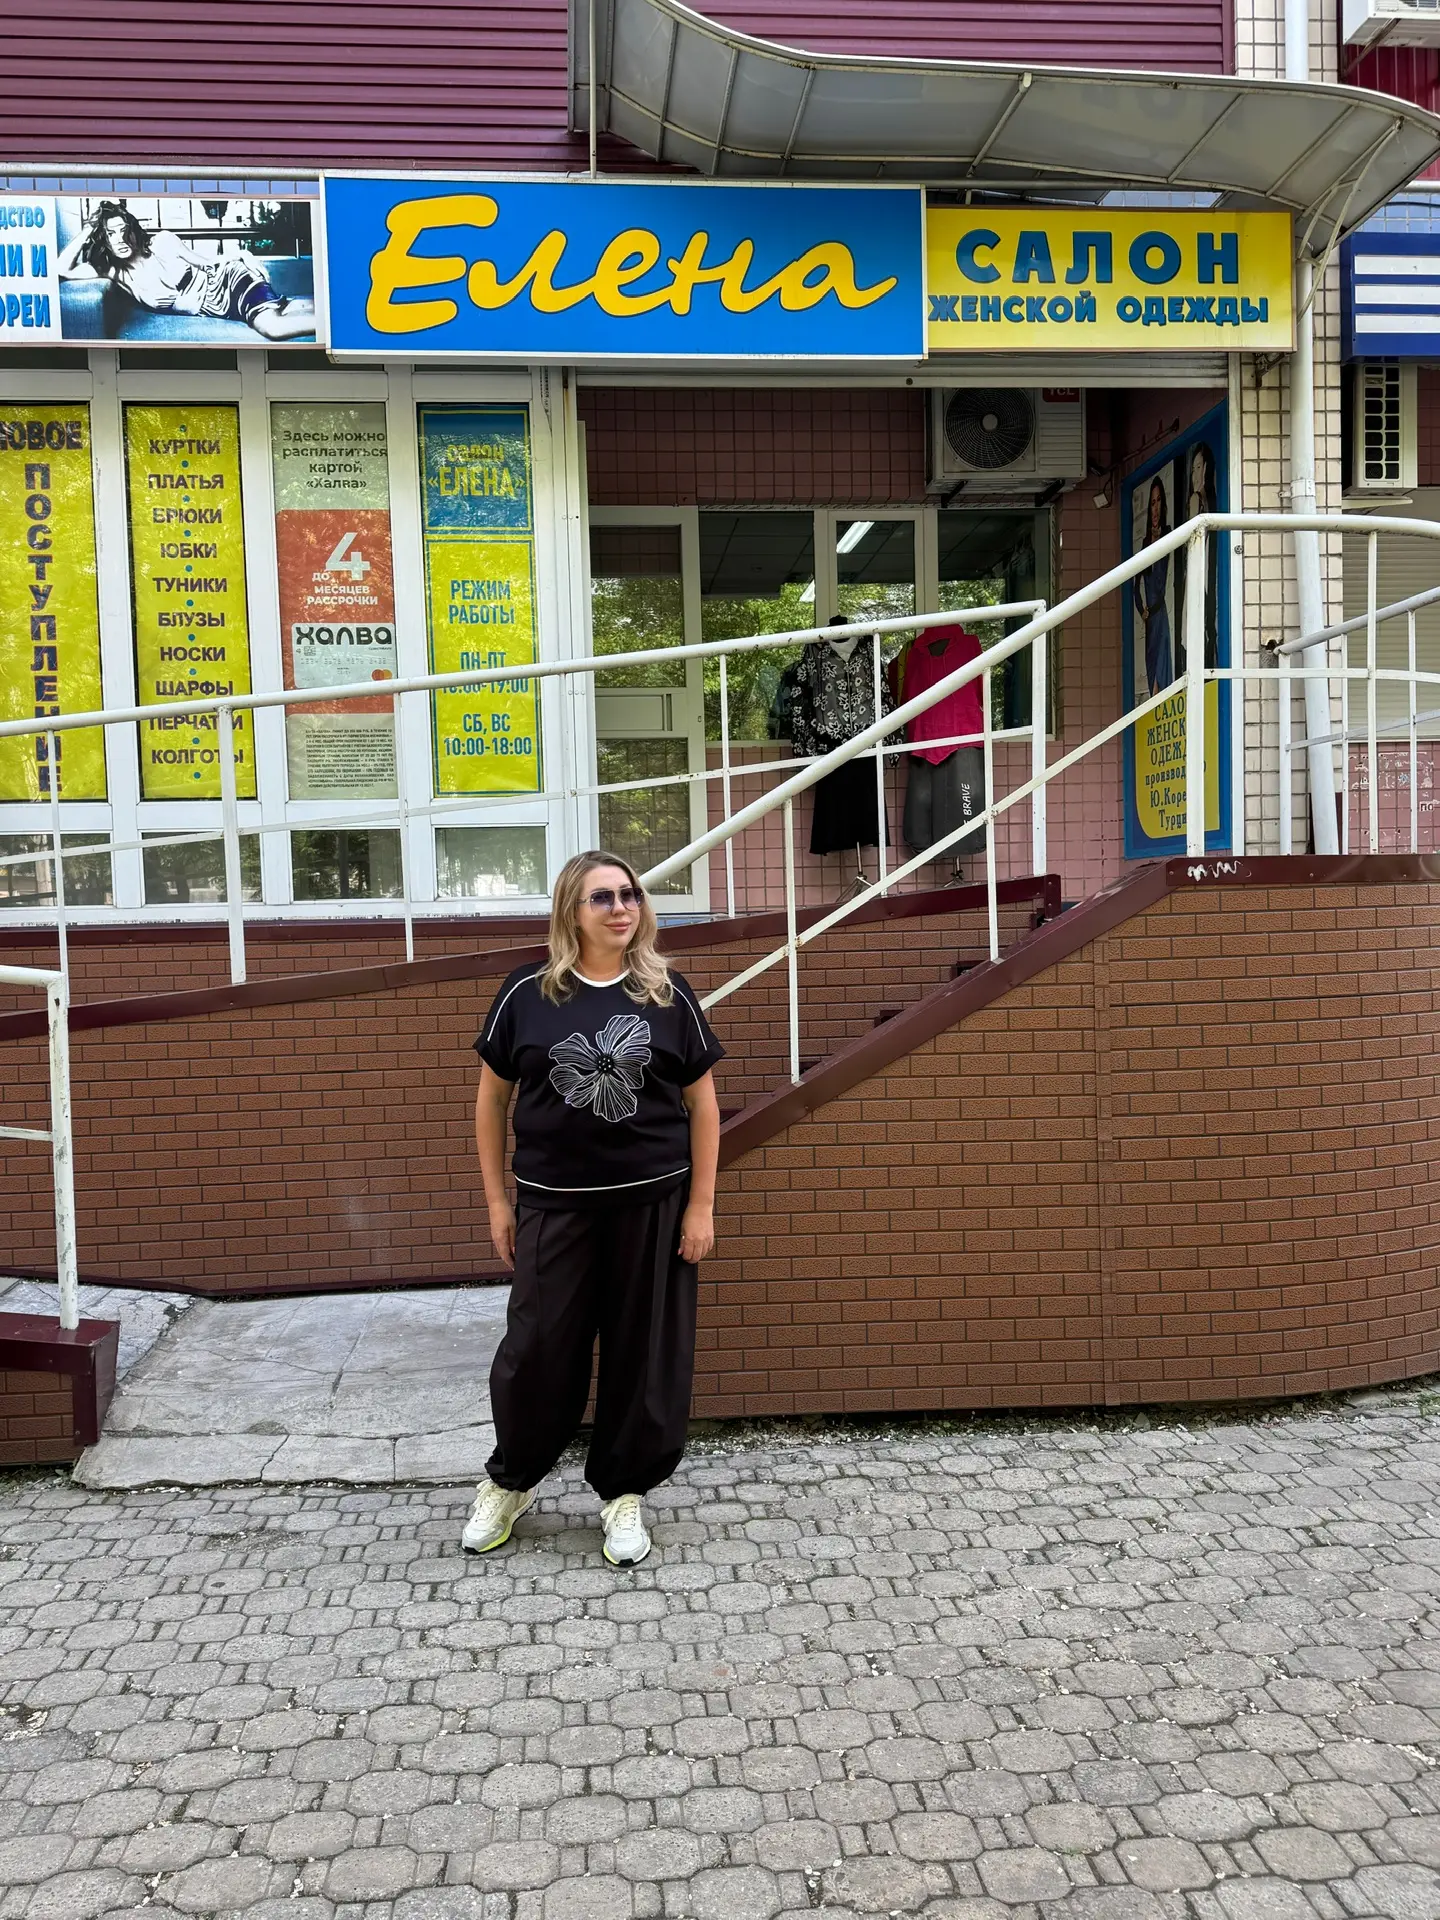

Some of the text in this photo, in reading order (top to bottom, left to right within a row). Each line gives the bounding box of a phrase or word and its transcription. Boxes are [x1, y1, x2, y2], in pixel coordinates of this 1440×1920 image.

[366, 193, 898, 333] Елена
[956, 229, 1239, 284] САЛОН
[928, 291, 1268, 326] ЖЕНСКОЙ ОДЕЖДЫ
[282, 431, 385, 442] Здесь можно
[149, 440, 220, 454] КУРТКИ
[282, 448, 388, 459] расплатиться
[309, 462, 363, 475] картой
[148, 474, 224, 489] ПЛАТЬЯ
[306, 478, 367, 490] «Халва»
[153, 508, 222, 523] БРЮКИ
[160, 543, 217, 558] ЮБКИ
[325, 532, 371, 581] 4
[152, 577, 228, 592] ТУНИКИ
[314, 585, 370, 595] МЕСЯЦЕВ
[450, 579, 511, 600] РЕЖИМ
[307, 595, 378, 605] РАССРОЧКИ
[158, 612, 225, 627] БЛУЗЫ
[449, 605, 514, 624] РАБОТЫ
[160, 646, 225, 661] НОСКИ
[459, 651, 506, 670] ПН-ПТ
[155, 680, 233, 696] ШАРФЫ
[1154, 695, 1187, 721] САЛО
[150, 715, 243, 730] ПЕРЧАТИ
[463, 713, 511, 734] СБ, ВС
[443, 737, 532, 755] 10:00-18:00
[961, 783, 972, 816] BRAVE
